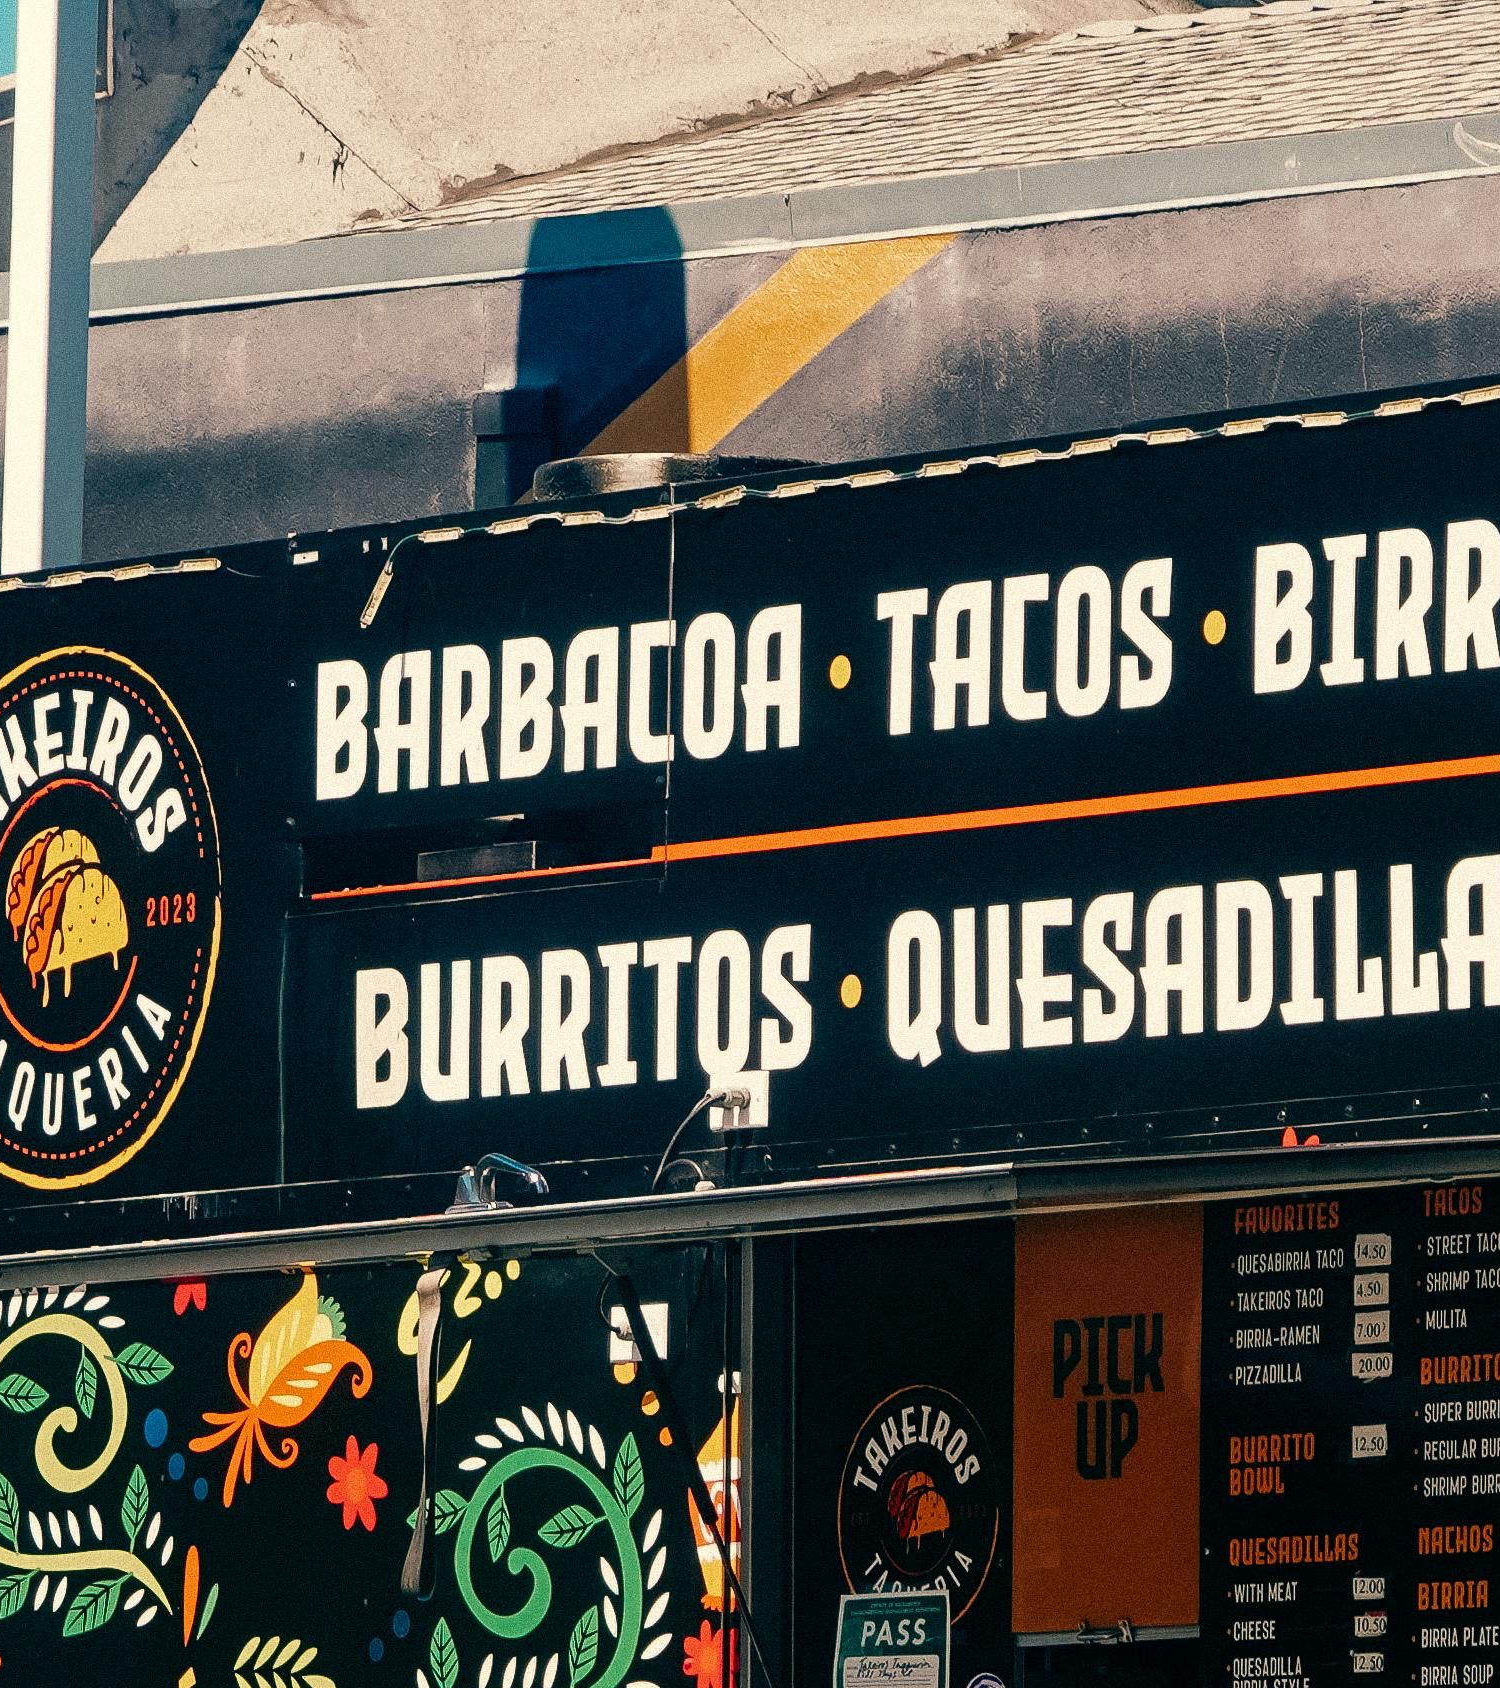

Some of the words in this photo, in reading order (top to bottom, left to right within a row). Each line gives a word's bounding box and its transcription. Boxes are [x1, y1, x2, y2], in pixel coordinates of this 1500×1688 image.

[313, 603, 802, 802] BARBACOA
[878, 557, 1173, 734] TACOS
[146, 893, 196, 928] 2023
[355, 925, 812, 1115] BURRITOS
[1424, 1187, 1482, 1216] TACOS
[1234, 1202, 1339, 1233] FAVORITES
[1237, 1250, 1311, 1275] QUESABIRRIA
[1317, 1248, 1344, 1269] TACO
[1356, 1244, 1386, 1260] 14.50
[1427, 1234, 1471, 1256] STREET
[1237, 1290, 1290, 1311] TAKEIROS
[1296, 1288, 1323, 1307] TACO
[1356, 1281, 1381, 1297] 4.50
[1426, 1271, 1470, 1292] SHRIMP
[1426, 1310, 1467, 1329] MULITA
[1235, 1325, 1320, 1349] BIRRIA-RAMEN
[1357, 1323, 1380, 1338] 7.00
[1053, 1313, 1165, 1399] PICK
[1235, 1364, 1302, 1385] PIZZADILLA
[1358, 1357, 1390, 1374] 20.00
[1424, 1401, 1461, 1423] SUPER
[853, 1405, 981, 1491] TAKEIROS
[1076, 1399, 1139, 1480] UP
[1230, 1433, 1315, 1464] BURRITO
[1355, 1435, 1384, 1452] 12.50
[1424, 1439, 1477, 1460] REGULAR
[1230, 1467, 1284, 1495] BOWL
[1423, 1476, 1467, 1497] SHRIMP
[1230, 1533, 1358, 1567] QUESADILLAS
[1418, 1524, 1493, 1554] NACHOS
[1234, 1584, 1264, 1603] WITH
[1268, 1582, 1298, 1601] MEAT
[1354, 1579, 1383, 1594] 12.00
[1418, 1580, 1488, 1610] BIRRIA
[861, 1618, 926, 1647] PASS
[1233, 1621, 1275, 1641] CHEESE
[1357, 1617, 1386, 1633] 10.50
[1421, 1628, 1459, 1648] BIRRIA
[1463, 1626, 1499, 1646] PLATE
[1233, 1656, 1301, 1679] QUESADILLA
[1354, 1656, 1382, 1671] 12.50
[1421, 1666, 1458, 1686] BIRRIA
[1463, 1664, 1493, 1684] SOUP
